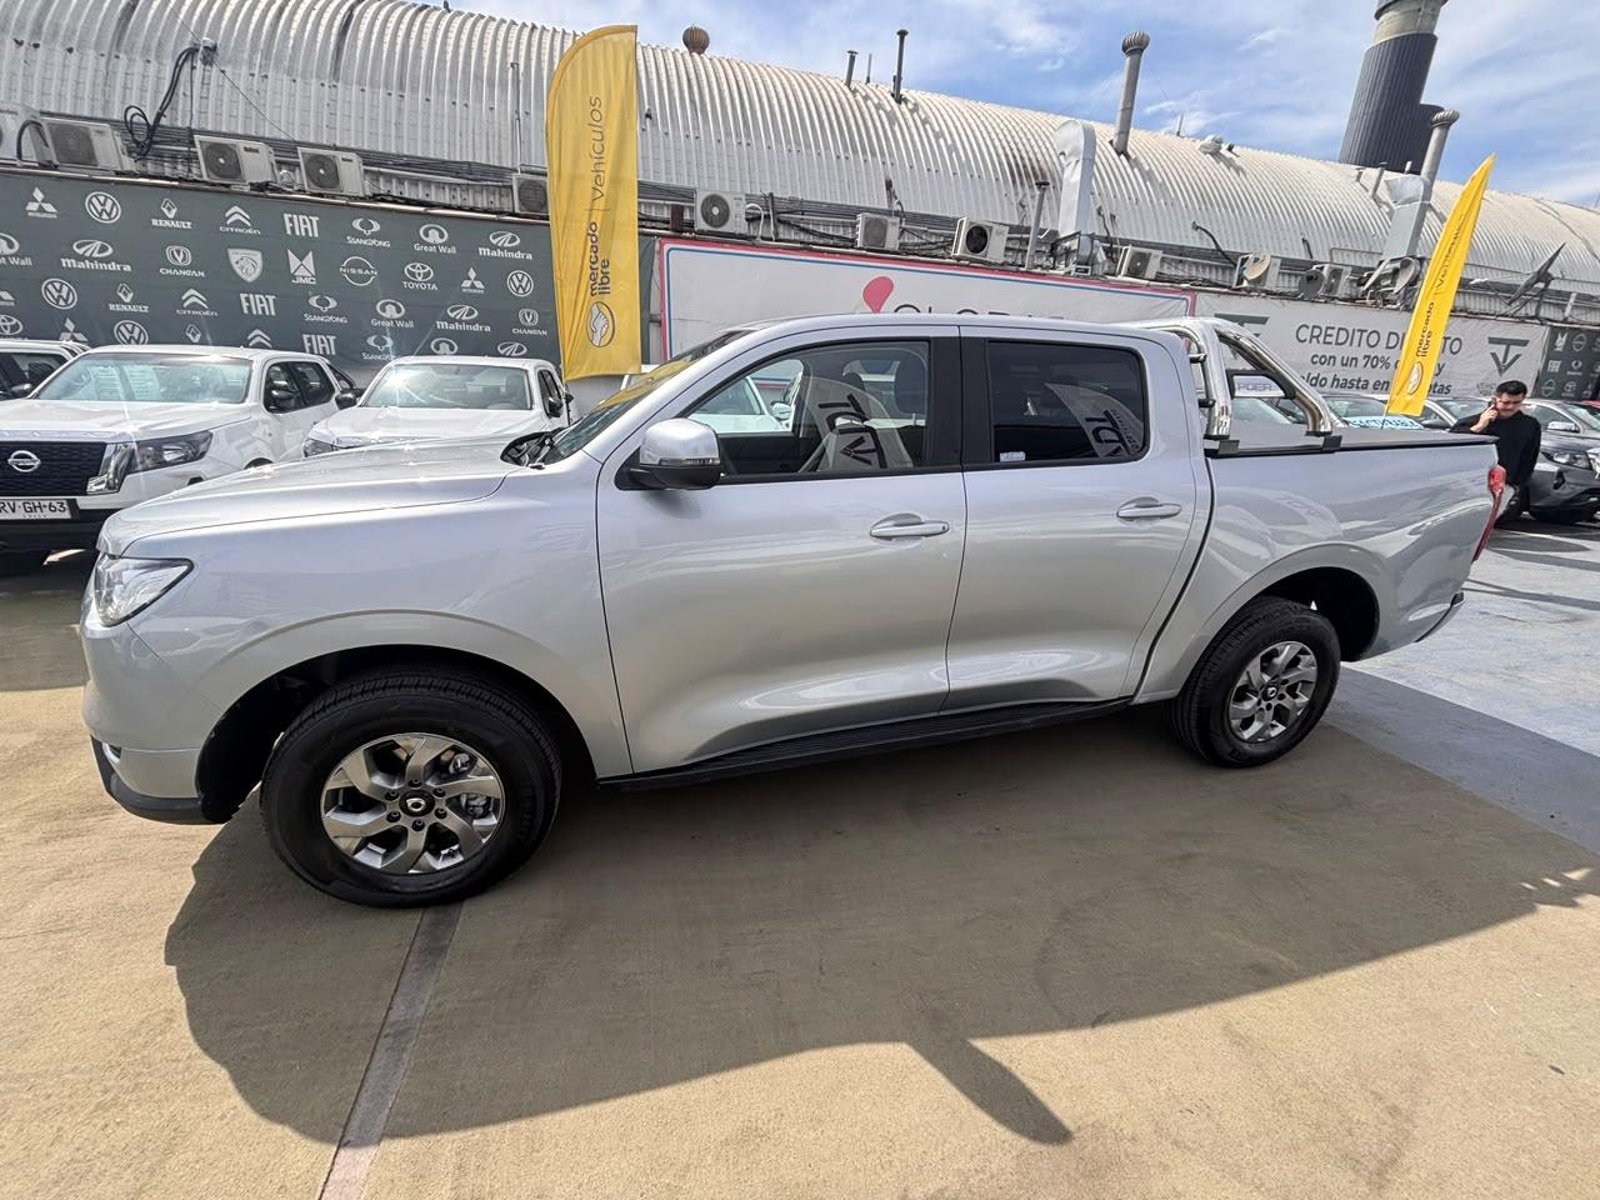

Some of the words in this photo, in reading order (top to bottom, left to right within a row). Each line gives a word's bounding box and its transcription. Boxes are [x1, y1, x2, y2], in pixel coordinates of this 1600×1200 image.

[283, 213, 319, 238] FIAT
[413, 243, 437, 253] Great
[438, 245, 457, 255] Wall
[478, 247, 533, 260] Mahindra
[60, 258, 132, 272] Mahindra
[587, 221, 599, 297] mercado
[339, 267, 379, 276] NISSAN
[598, 258, 611, 295] libre
[291, 276, 317, 285] JMC
[403, 281, 438, 291] TOYOTA
[240, 293, 277, 316] FIAT
[371, 318, 394, 328] Great
[436, 320, 491, 332] Mahindra
[302, 333, 336, 356] FIAT
[1295, 324, 1381, 349] CREDITO
[1385, 331, 1463, 355] DITO
[1310, 354, 1337, 367] con
[1340, 356, 1358, 369] un
[1362, 355, 1391, 370] 70%
[1330, 373, 1370, 390] hasta
[1372, 379, 1391, 392] en
